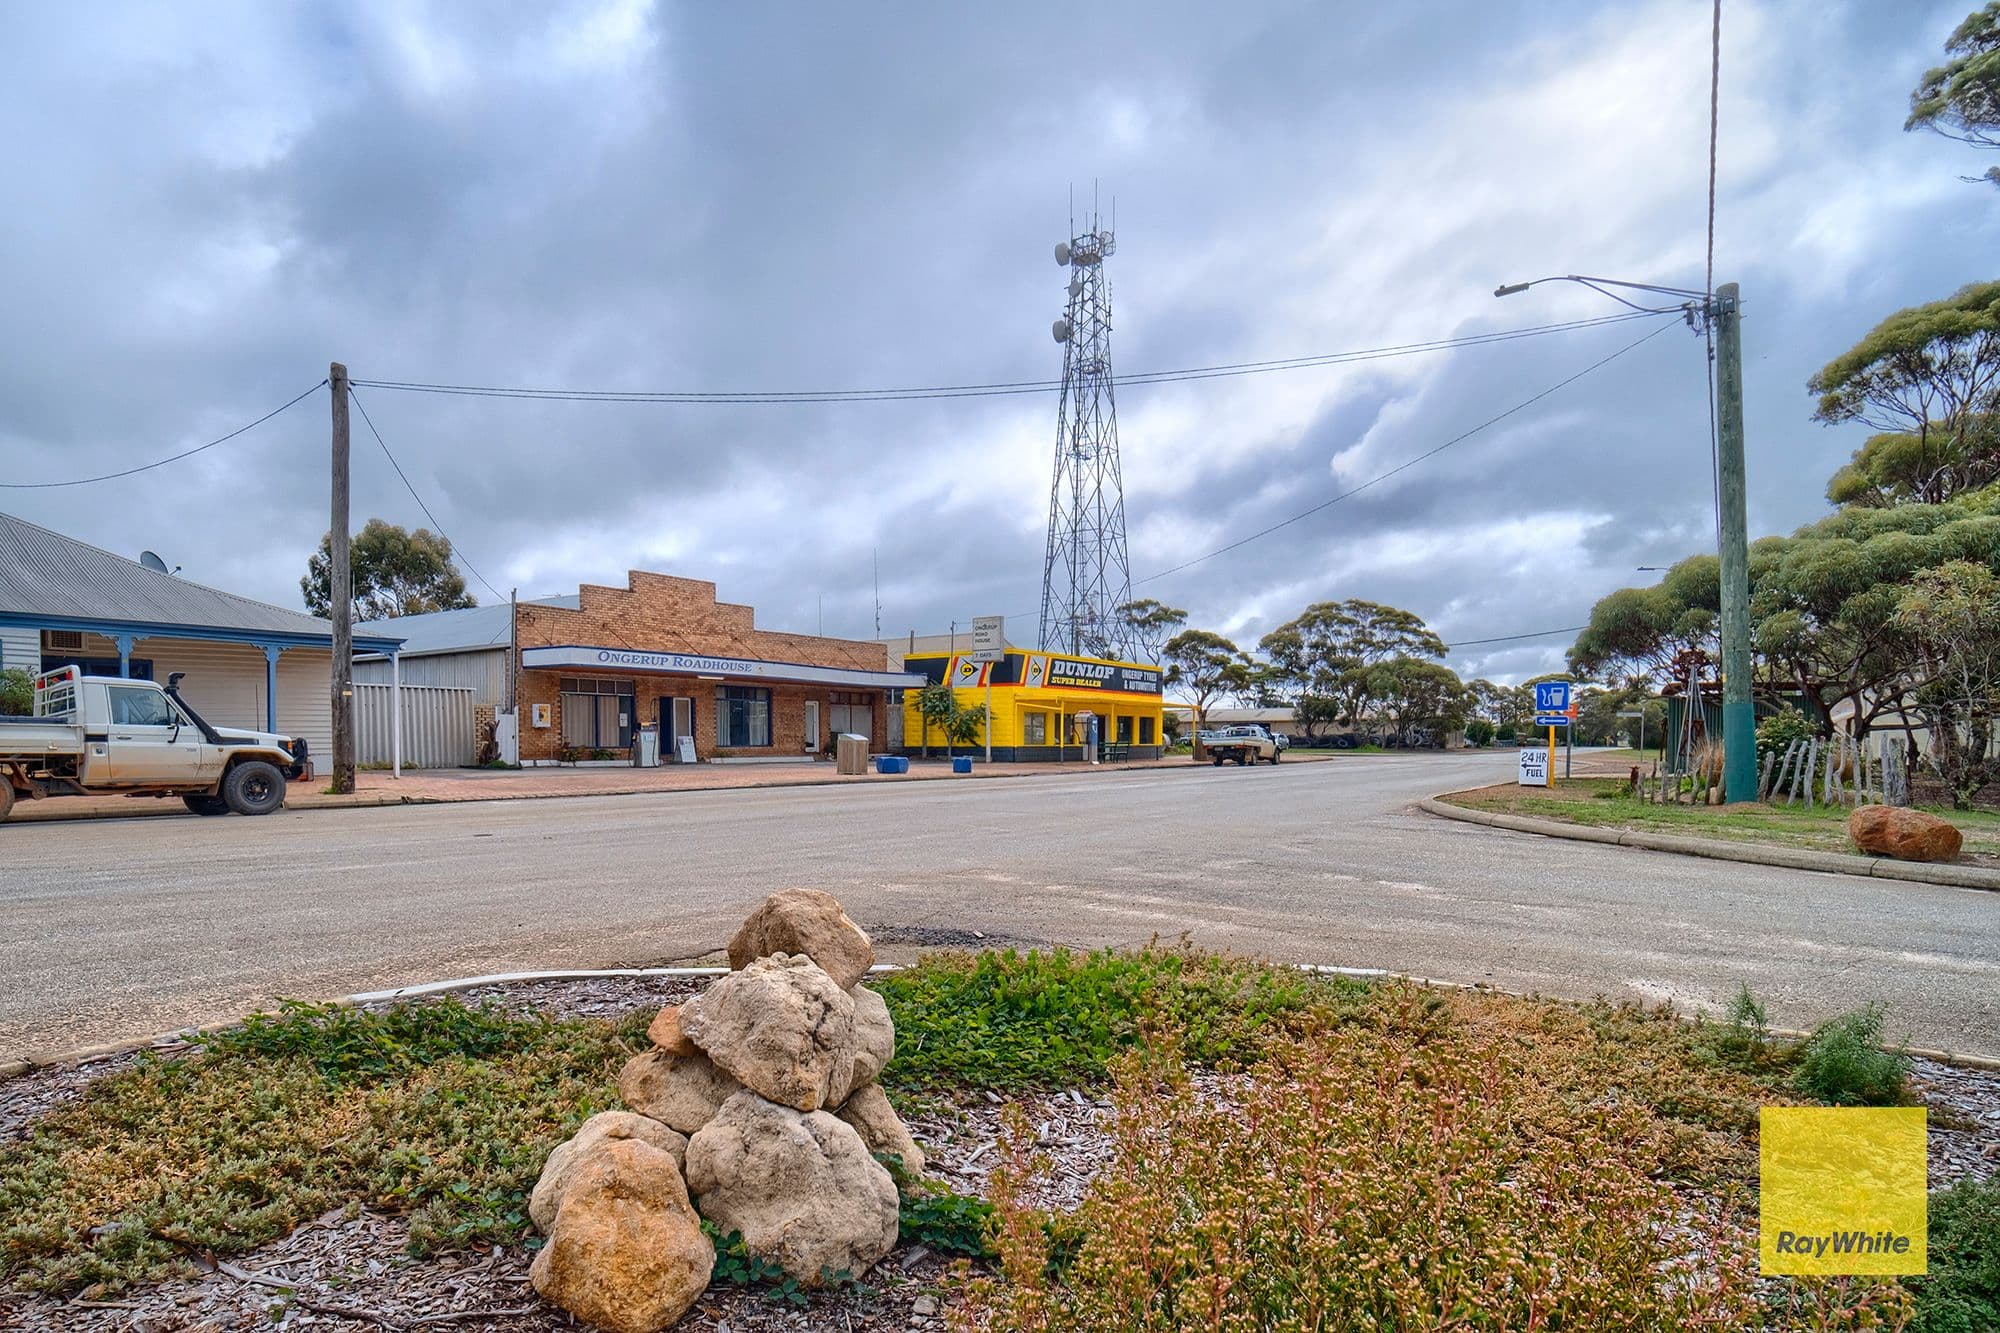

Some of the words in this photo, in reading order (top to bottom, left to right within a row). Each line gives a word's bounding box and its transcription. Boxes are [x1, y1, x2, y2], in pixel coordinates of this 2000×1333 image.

[1053, 661, 1114, 679] DUNLOP
[1051, 676, 1075, 685] SUPER
[1076, 678, 1101, 687] DEALER
[1143, 672, 1157, 682] TYRES
[1521, 752, 1534, 762] 24
[1535, 753, 1547, 763] HR
[1526, 769, 1543, 777] FUEL
